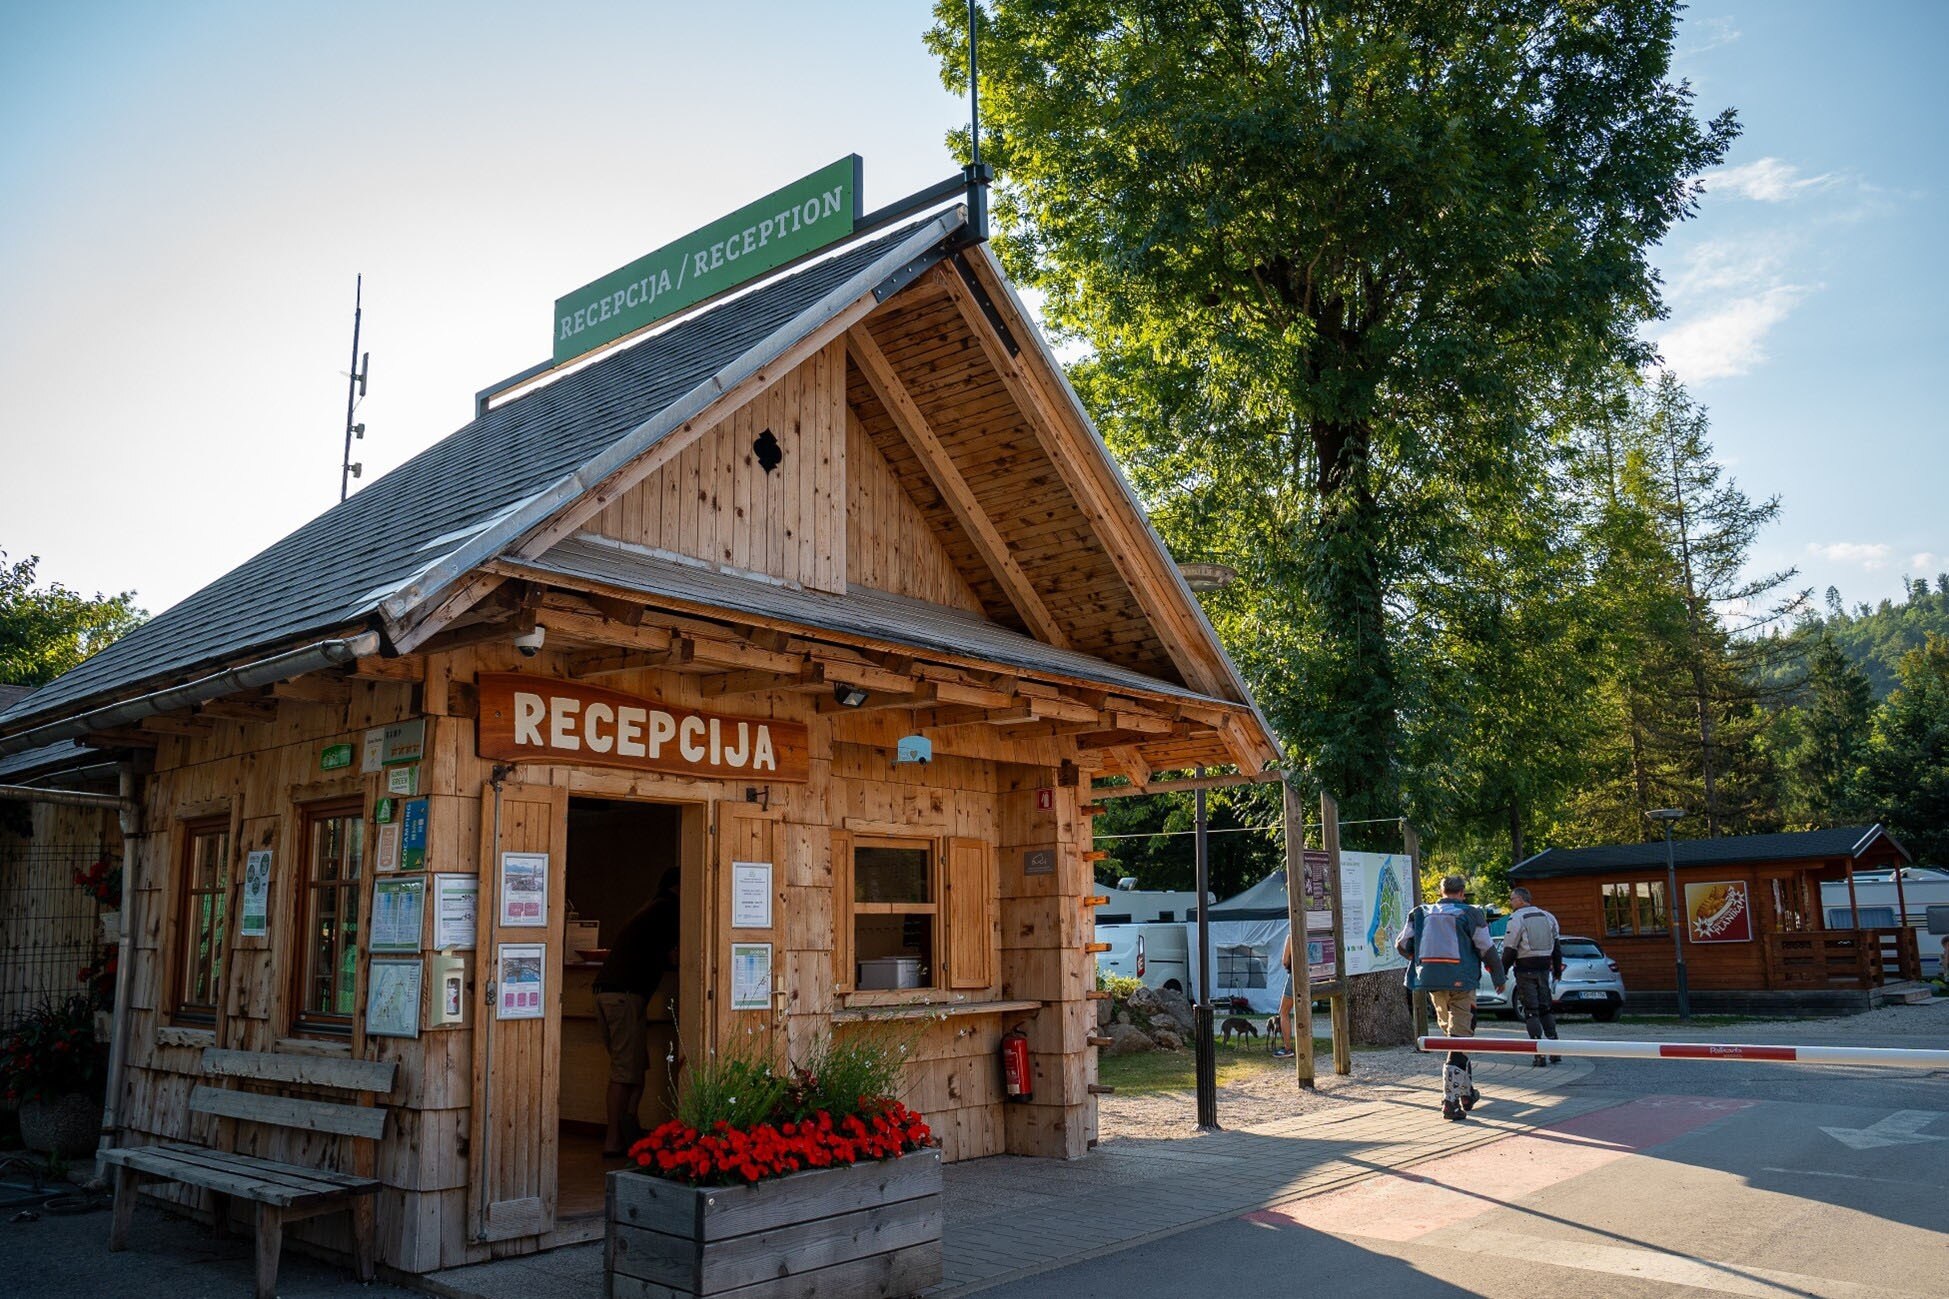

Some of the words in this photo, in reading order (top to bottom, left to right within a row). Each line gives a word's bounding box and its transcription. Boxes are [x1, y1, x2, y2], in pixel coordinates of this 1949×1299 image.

[560, 268, 672, 341] RECEPCIJA
[693, 185, 843, 278] RECEPTION
[514, 692, 776, 771] RECEPCIJA
[401, 804, 412, 868] ECOCAMPING
